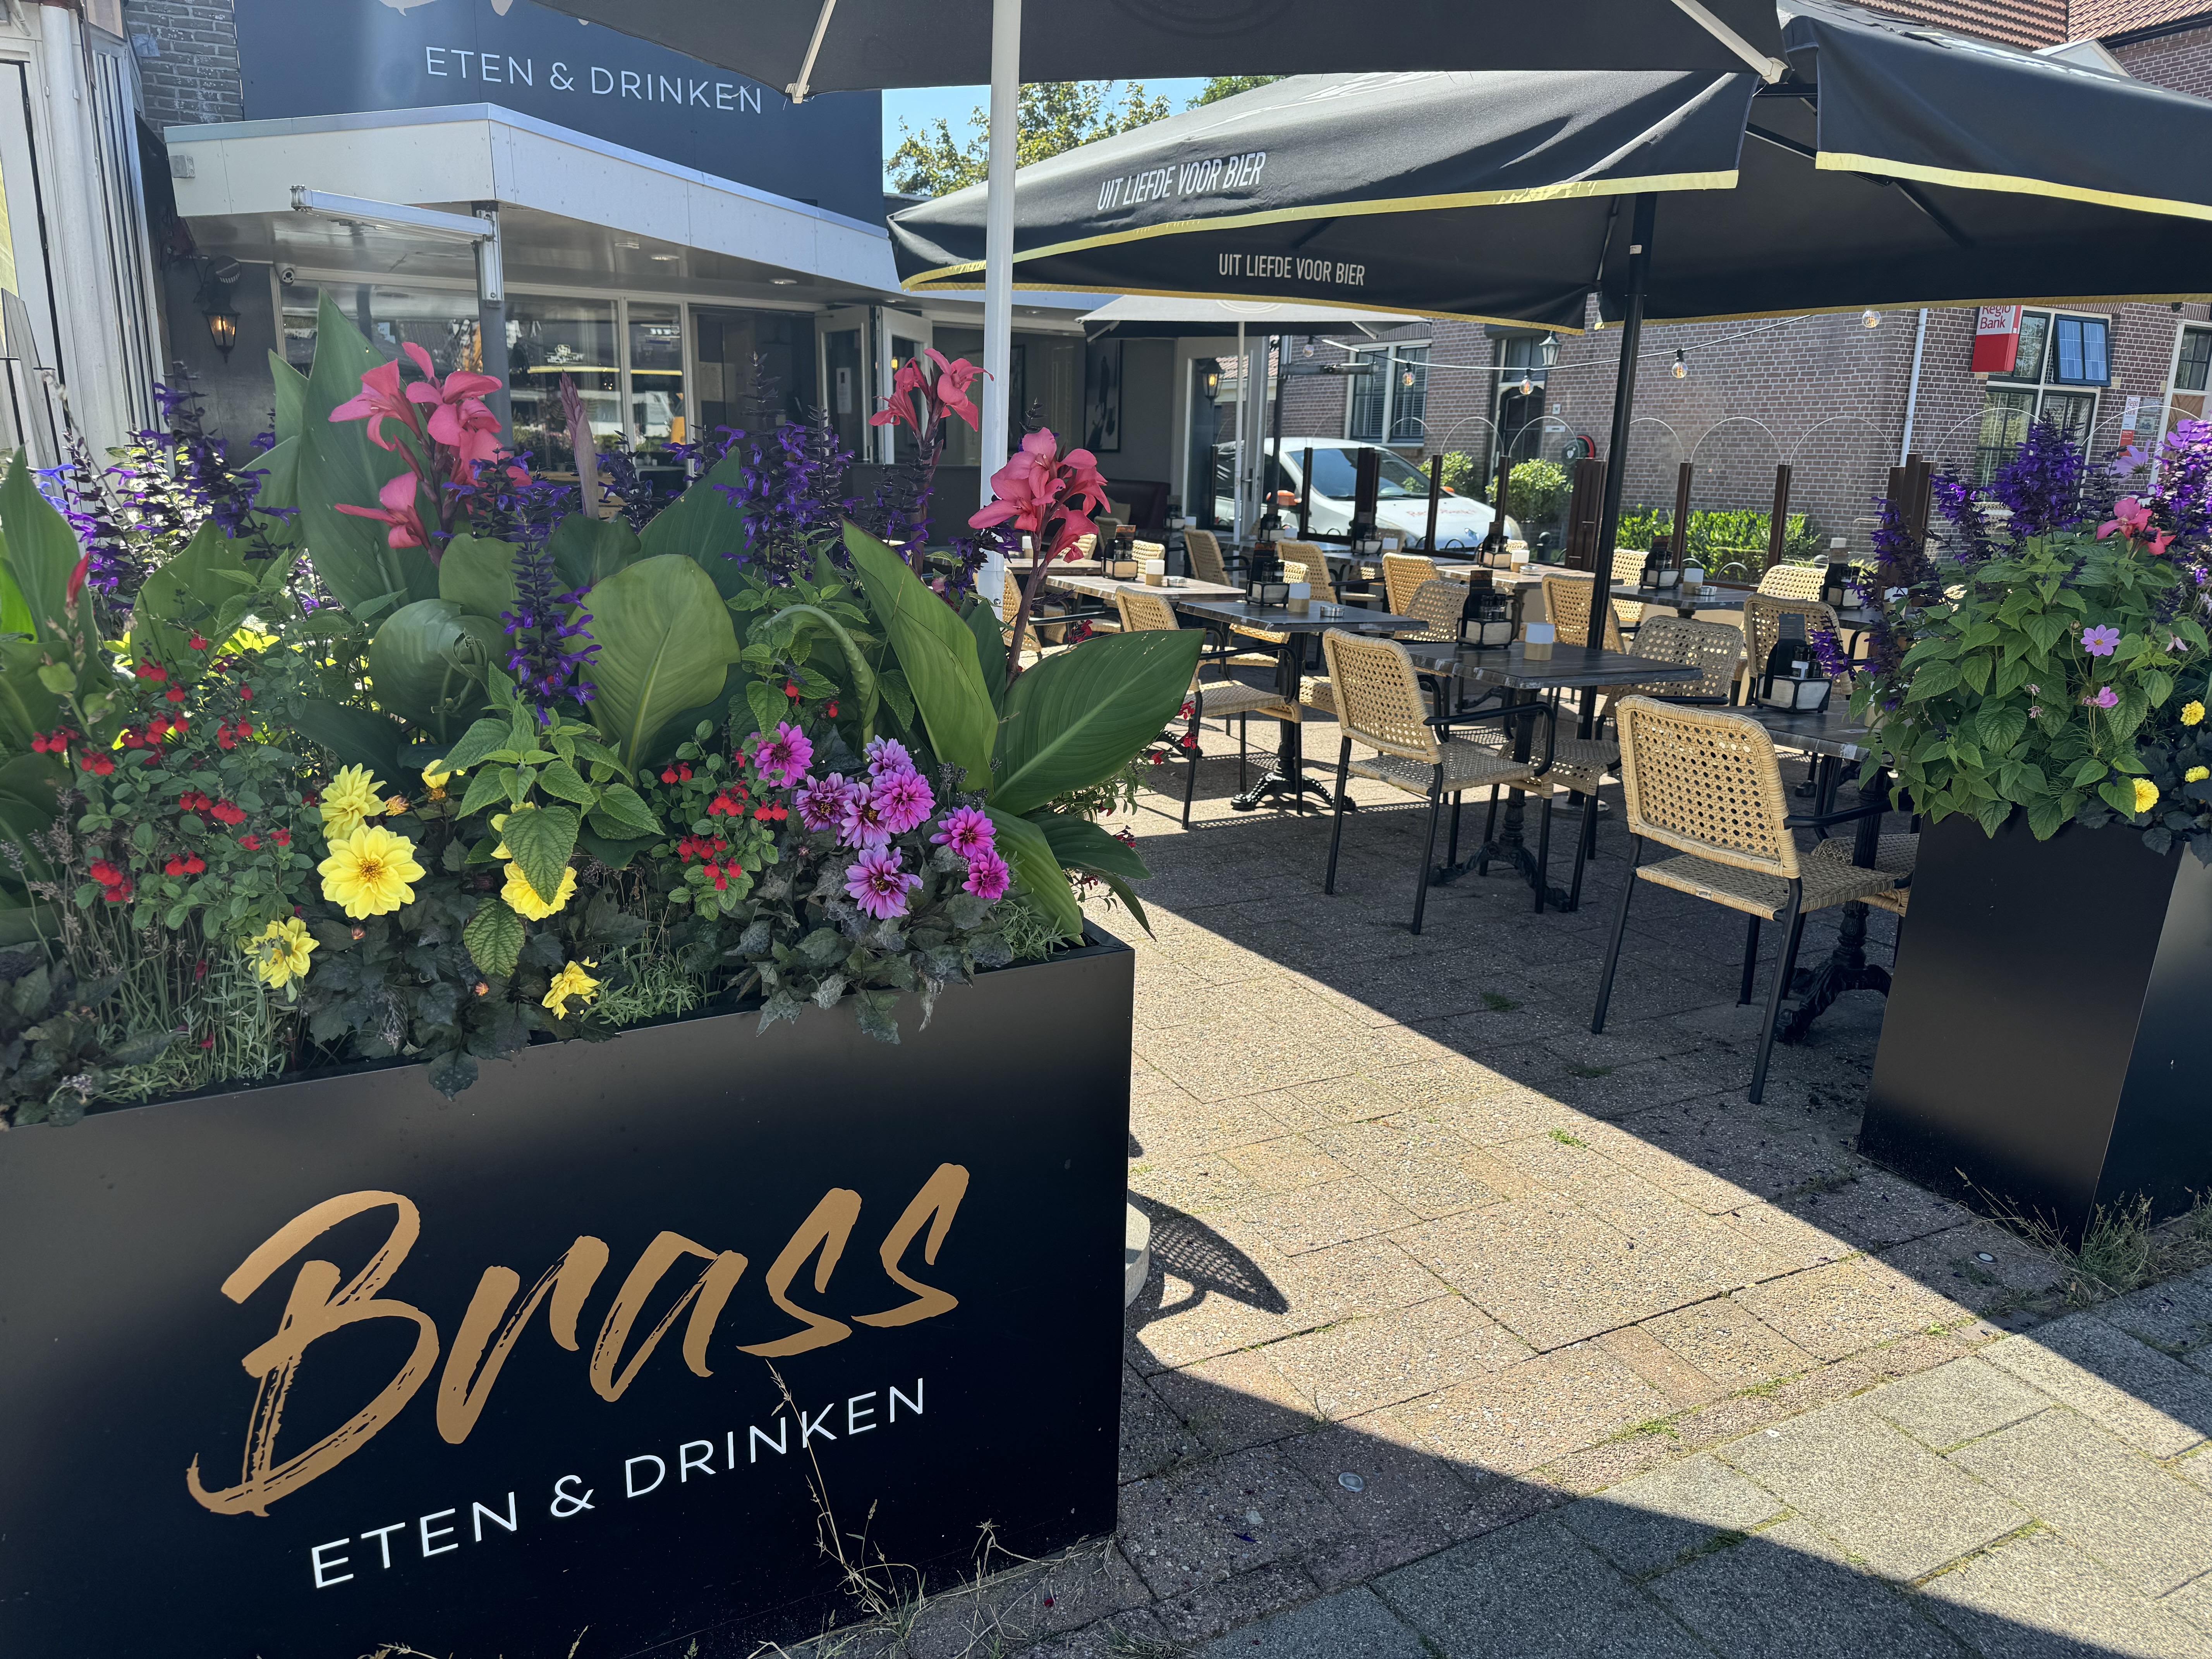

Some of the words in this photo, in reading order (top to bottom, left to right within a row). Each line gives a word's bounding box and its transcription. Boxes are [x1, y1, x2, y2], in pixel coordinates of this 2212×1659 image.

[426, 46, 533, 86] ETEN
[550, 62, 575, 91] &
[591, 66, 761, 114] DRINKEN
[1096, 177, 1123, 211] UIT
[1122, 165, 1176, 206] LIEFDE
[1177, 158, 1222, 196] VOOR
[1222, 151, 1266, 189] BIER
[1219, 253, 1242, 276] UIT
[1246, 254, 1292, 278] LIEFDE
[1296, 257, 1332, 282] VOOR
[1335, 263, 1365, 286] BIER
[1980, 315, 2006, 329] Bank
[1982, 305, 2011, 317] Regio
[187, 1163, 970, 1517] Brass
[311, 1491, 518, 1589] ETEN
[550, 1474, 596, 1518] &
[624, 1377, 925, 1499] DRINKEN
